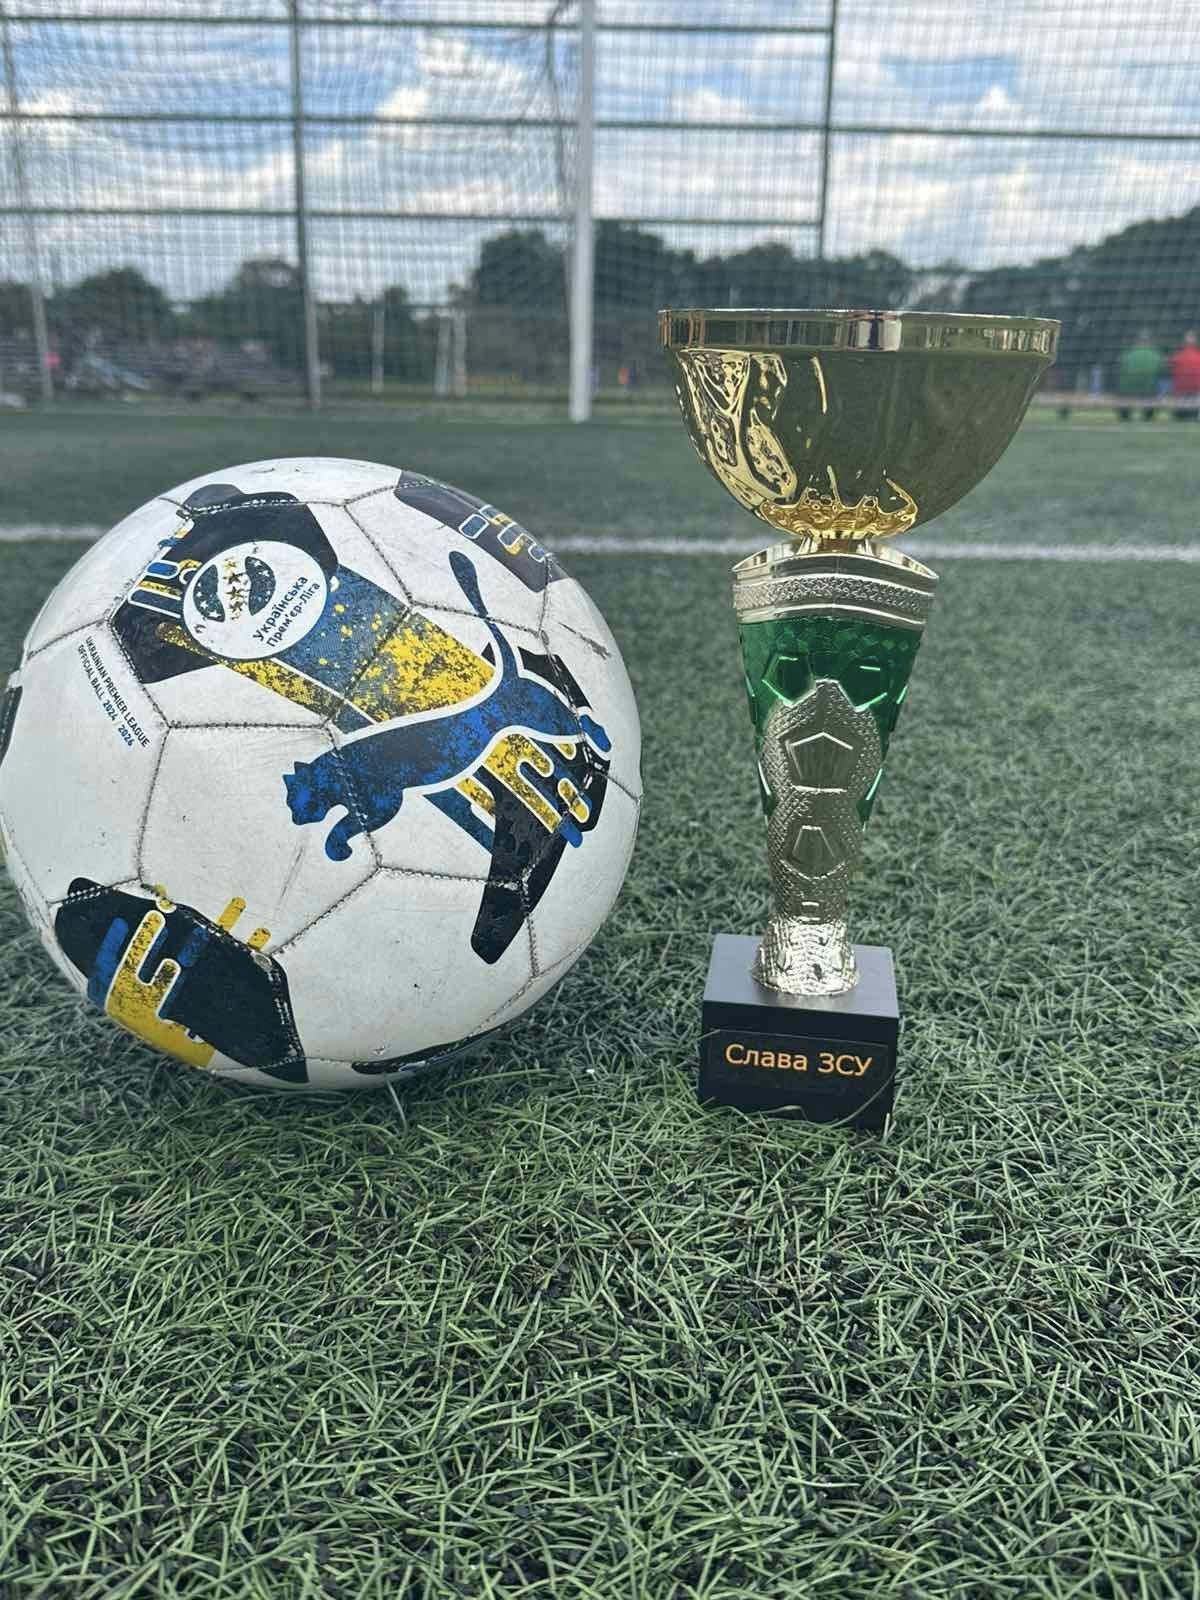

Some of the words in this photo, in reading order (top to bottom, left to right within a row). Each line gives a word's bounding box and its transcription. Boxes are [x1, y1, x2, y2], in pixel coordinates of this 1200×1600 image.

[252, 576, 309, 642] Українська
[78, 644, 95, 680] OFFICIAL
[91, 677, 105, 701] BALL
[102, 699, 119, 721] 2024
[118, 723, 135, 747] 2026
[85, 636, 109, 679] UKRAINIAN
[103, 675, 129, 715] PREMIER
[123, 711, 151, 748] LEAGUE
[725, 1043, 809, 1072] Слава
[817, 1052, 873, 1077] ЗСУ
